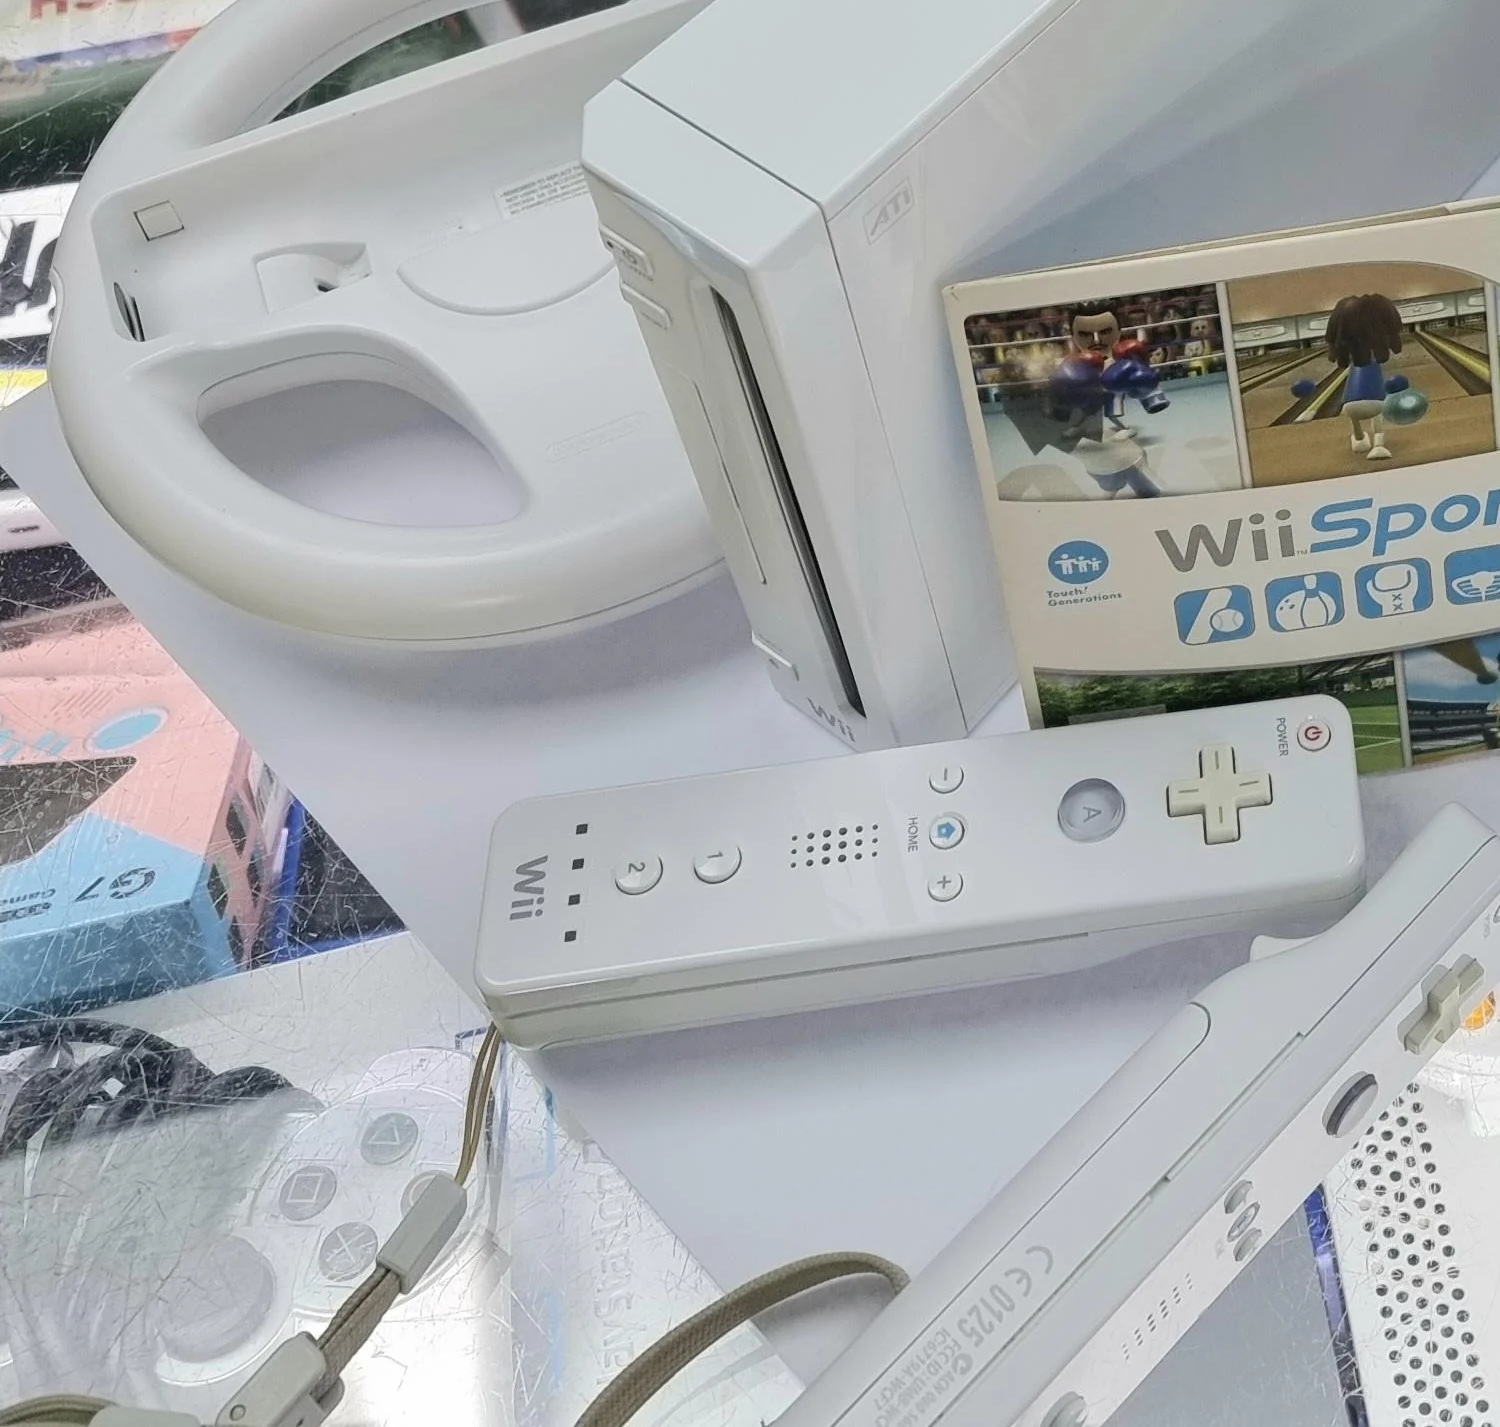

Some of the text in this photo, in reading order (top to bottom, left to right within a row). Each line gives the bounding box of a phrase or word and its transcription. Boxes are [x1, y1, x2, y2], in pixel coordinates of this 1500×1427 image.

[868, 188, 911, 237] ATI
[1047, 586, 1087, 599] Touch!
[1048, 592, 1122, 607] Generations
[1277, 717, 1288, 757] POWER
[1082, 806, 1102, 823] A
[907, 816, 919, 853] HOME
[629, 862, 647, 874] 2
[509, 854, 549, 921] Wii
[957, 1283, 1016, 1347] 0125
